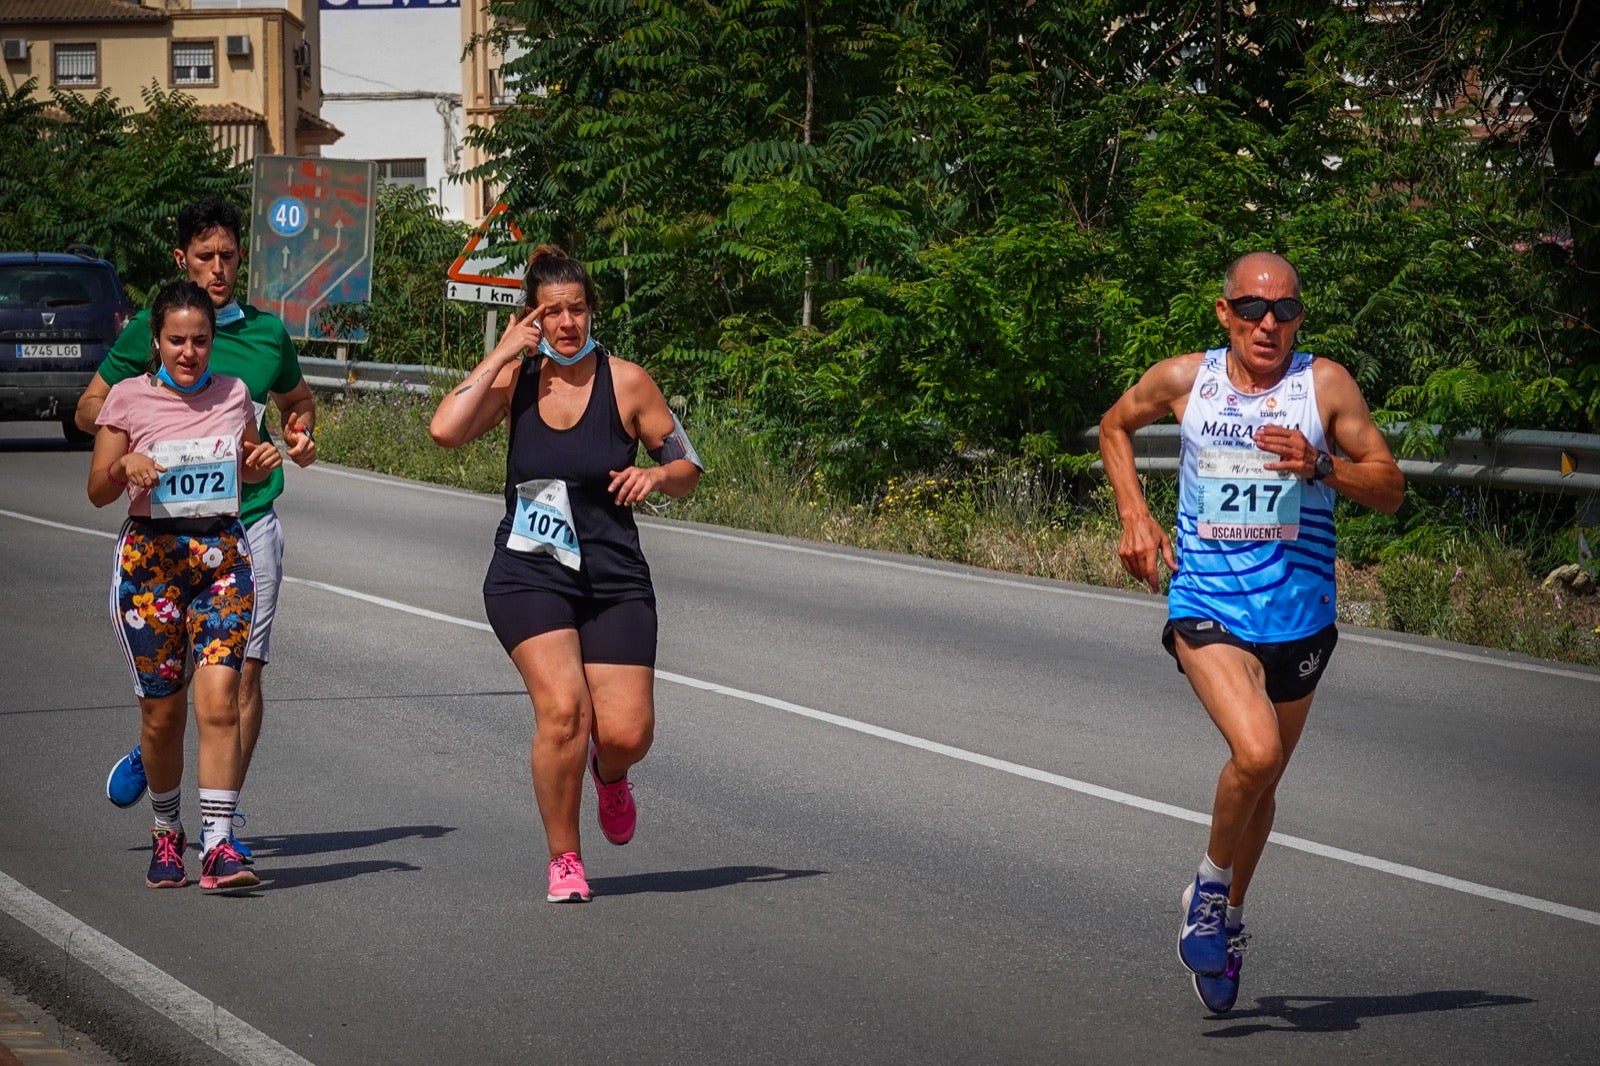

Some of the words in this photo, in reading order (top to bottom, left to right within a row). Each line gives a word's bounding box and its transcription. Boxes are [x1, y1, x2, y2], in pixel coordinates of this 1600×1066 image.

[275, 203, 300, 228] 40
[475, 286, 481, 300] 1
[490, 288, 514, 304] km
[24, 345, 53, 357] 4745
[56, 345, 79, 357] LGG
[1212, 439, 1233, 447] CLUB
[166, 471, 225, 496] 1072
[1220, 483, 1283, 512] 217
[1211, 526, 1242, 539] OSCAR
[1244, 526, 1282, 539] VICENTE
